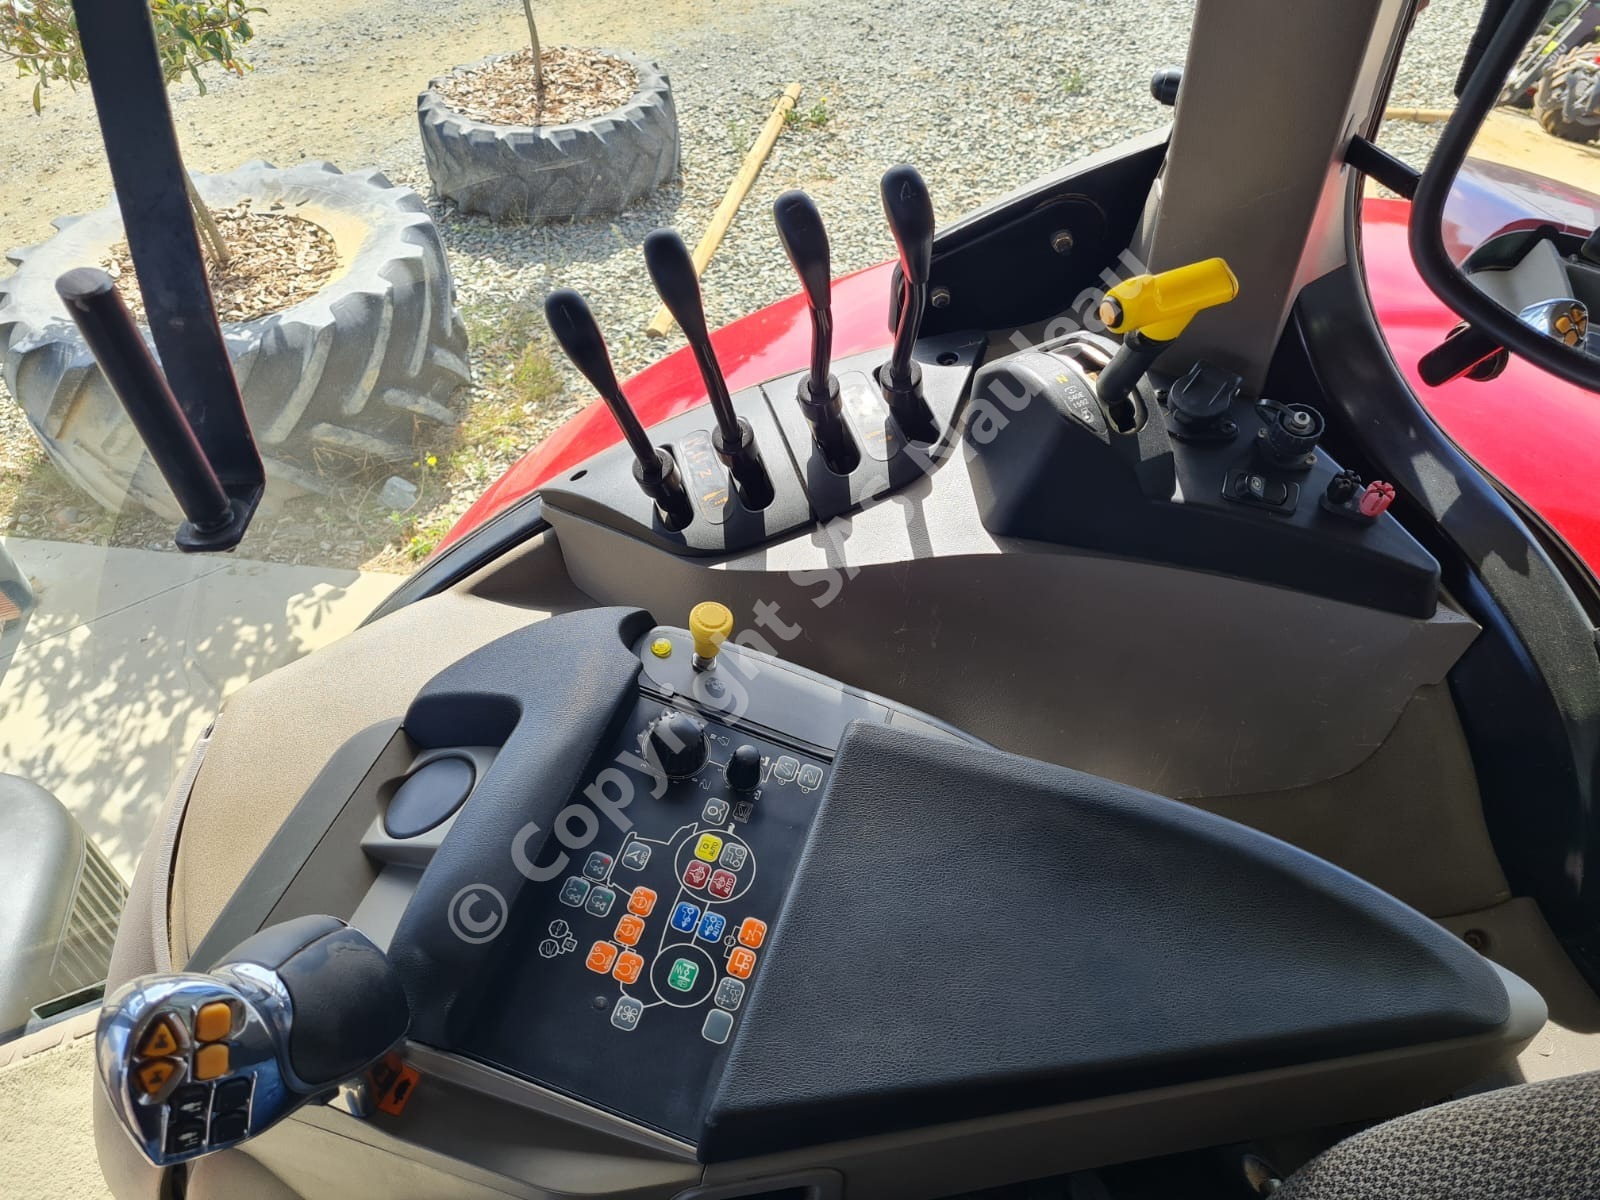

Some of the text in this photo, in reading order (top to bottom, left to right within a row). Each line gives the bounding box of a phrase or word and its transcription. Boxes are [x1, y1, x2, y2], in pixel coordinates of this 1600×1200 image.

[708, 841, 719, 857] AUTO
[638, 850, 649, 866] AUTO
[723, 877, 734, 895] AUTO
[712, 919, 723, 938] AUTO
